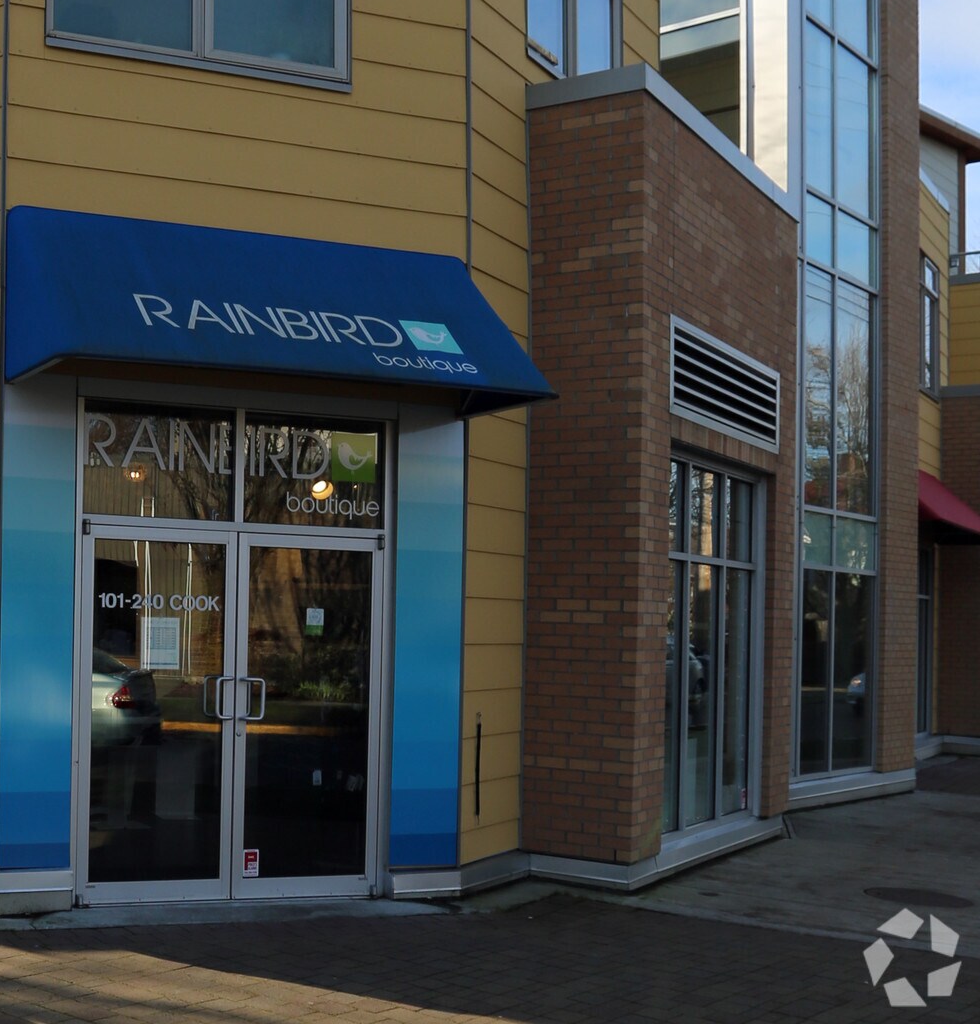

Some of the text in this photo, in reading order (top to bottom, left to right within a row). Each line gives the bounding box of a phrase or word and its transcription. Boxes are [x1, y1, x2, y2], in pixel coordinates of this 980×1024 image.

[132, 293, 403, 348] RAINBIRD
[372, 351, 478, 374] boutique
[286, 491, 380, 521] boutique
[99, 592, 220, 612] 101-240 COOK
